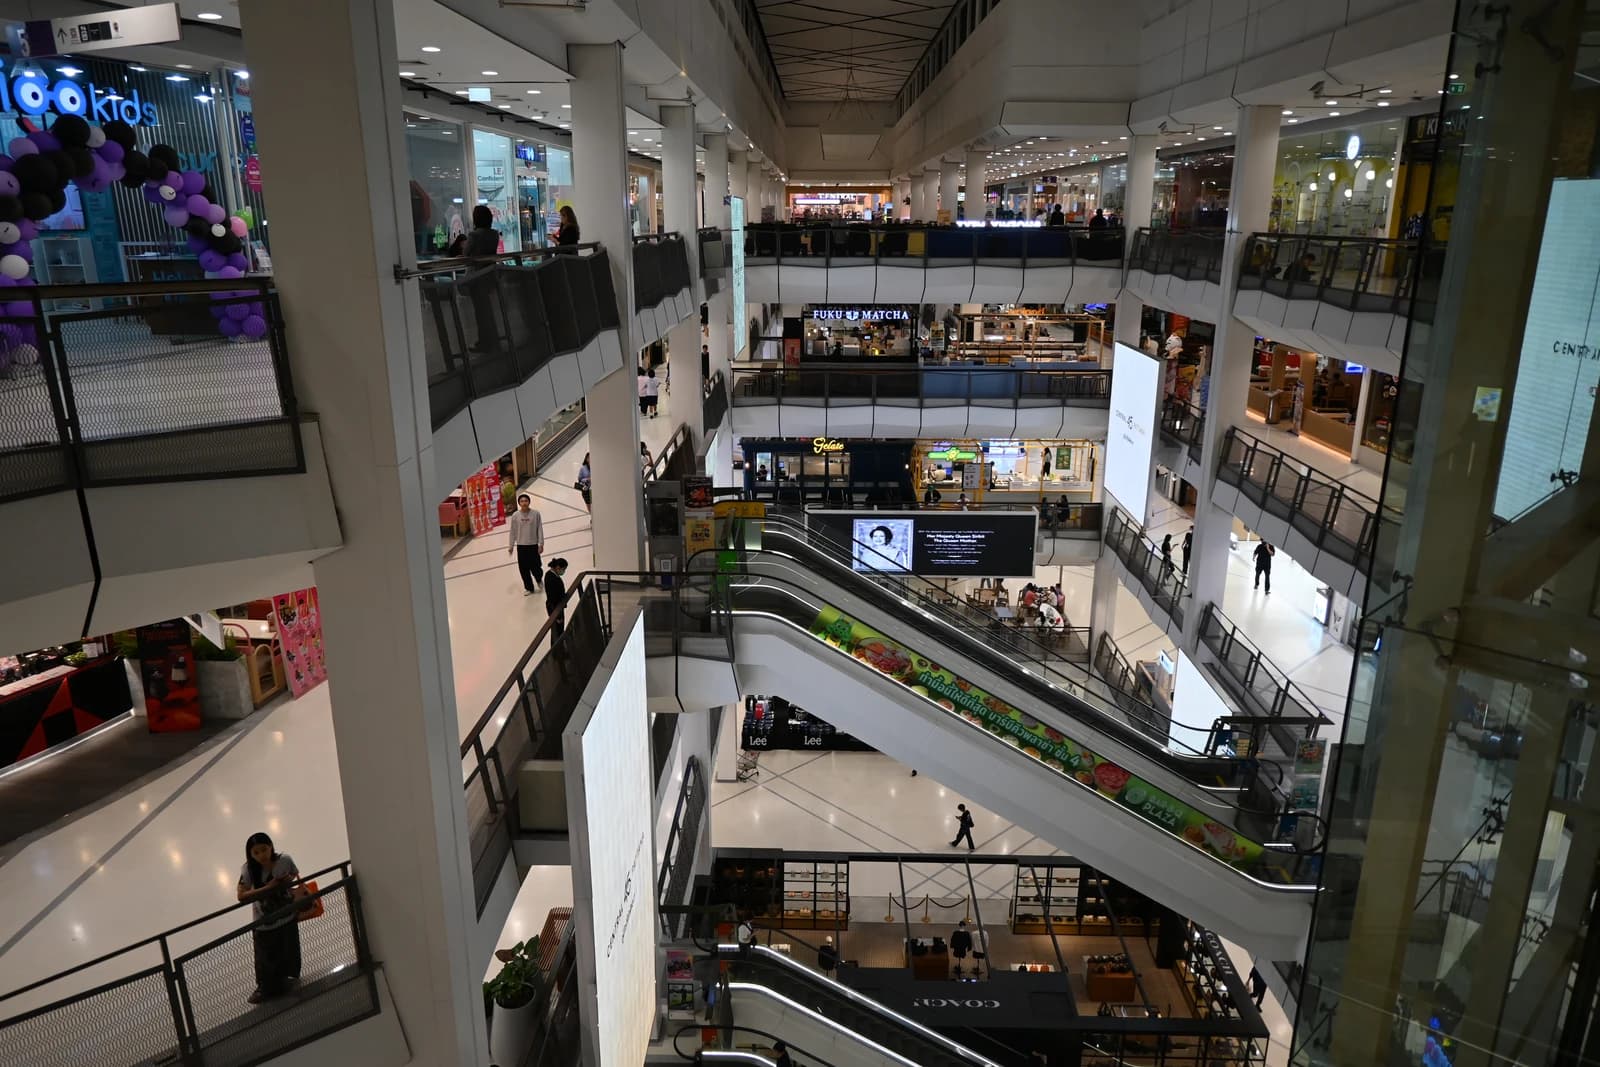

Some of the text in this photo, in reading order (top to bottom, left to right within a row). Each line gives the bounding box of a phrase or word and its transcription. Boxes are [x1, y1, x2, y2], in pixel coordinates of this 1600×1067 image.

[813, 310, 909, 320] FUKU MATCHA
[749, 736, 768, 746] Lee
[804, 735, 822, 746] Lee
[1069, 754, 1081, 767] 4
[1142, 803, 1177, 827] PLAZA
